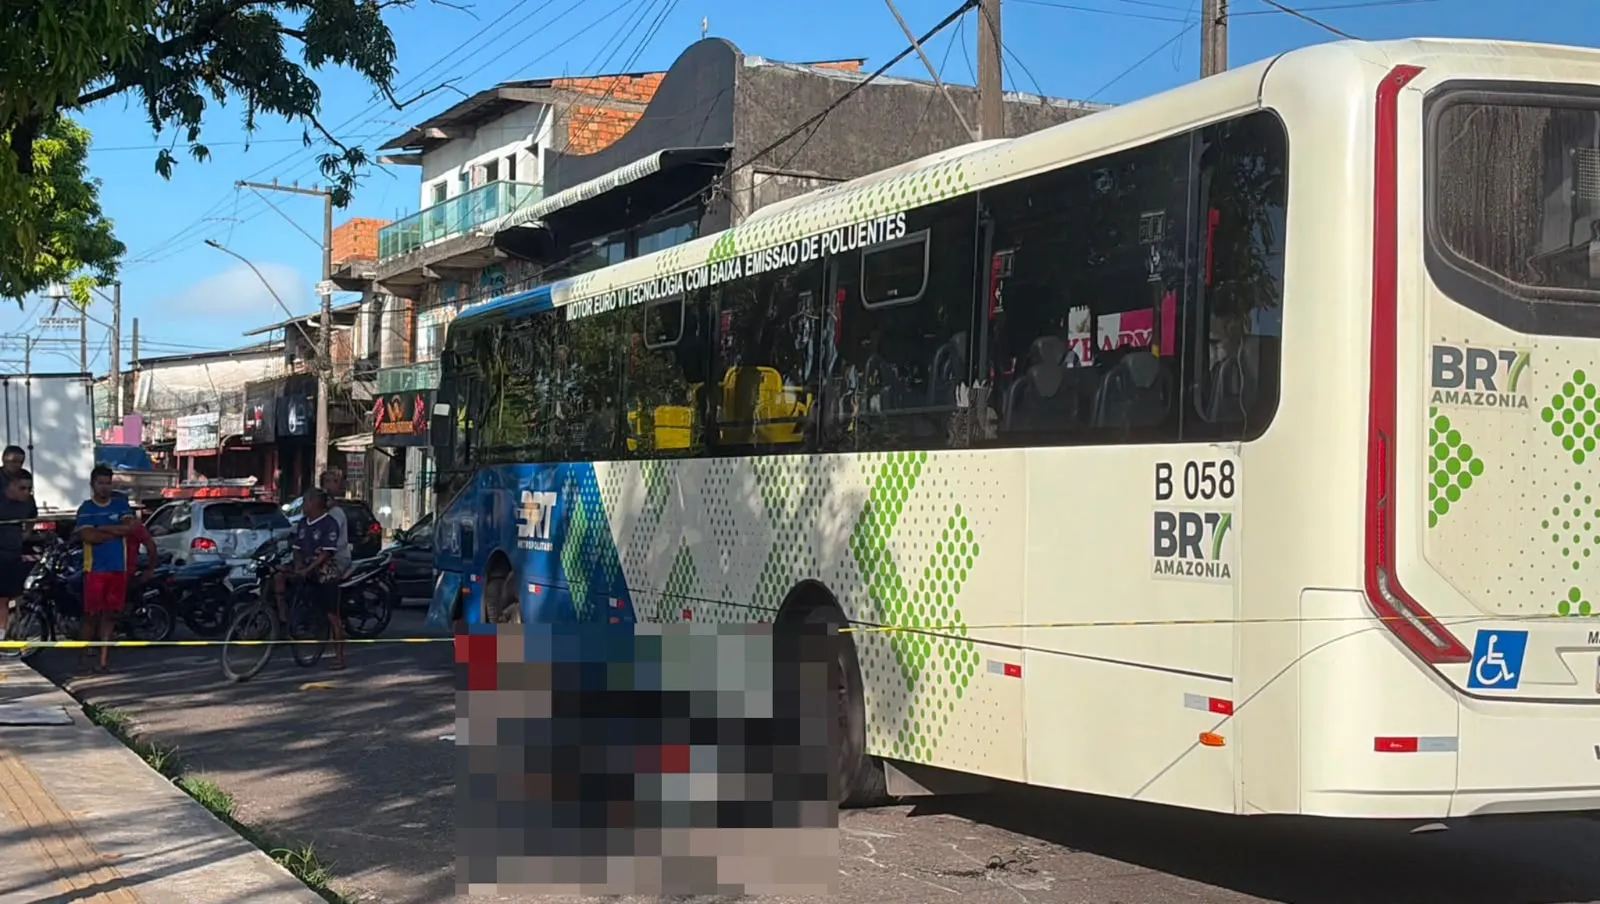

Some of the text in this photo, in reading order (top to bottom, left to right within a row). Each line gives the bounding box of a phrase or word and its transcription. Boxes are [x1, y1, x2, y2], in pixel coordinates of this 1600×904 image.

[566, 296, 593, 321] MOTOR
[594, 291, 616, 314] EURO
[617, 289, 627, 309] VI
[627, 275, 684, 305] TECNOLOGIA
[685, 267, 709, 292] COM
[710, 257, 742, 285] BAIXA
[801, 236, 820, 263] DE
[821, 212, 906, 257] POLUENTES
[1431, 390, 1529, 409] AMAZONIA
[1155, 459, 1235, 501] B 058
[1154, 560, 1231, 579] AMAZONIA
